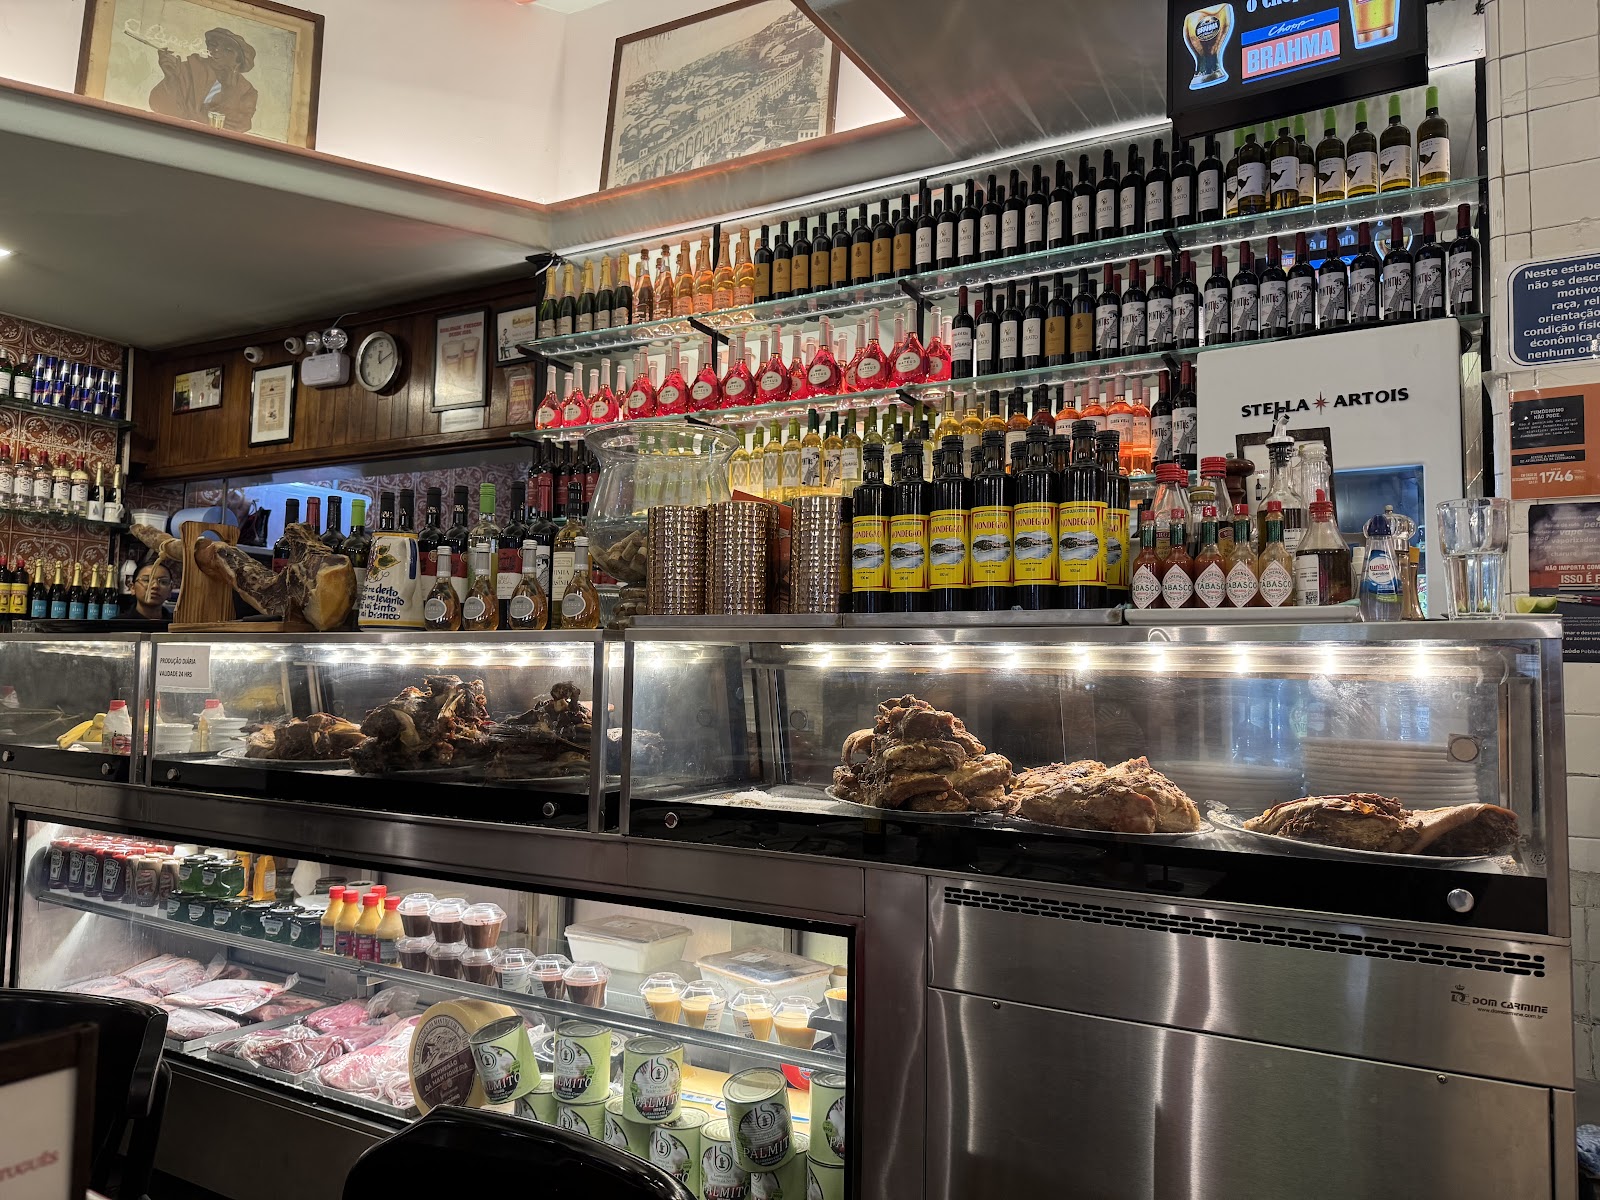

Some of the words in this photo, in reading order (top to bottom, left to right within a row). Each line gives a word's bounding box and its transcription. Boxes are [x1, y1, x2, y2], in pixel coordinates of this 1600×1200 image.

[1268, 18, 1315, 36] Chopp
[1247, 29, 1335, 74] BRAHMA
[1524, 268, 1558, 279] Neste
[1527, 281, 1549, 291] não
[1552, 278, 1566, 287] se
[1551, 300, 1581, 311] raça,
[1538, 308, 1600, 324] orientação
[1523, 323, 1576, 337] condição
[1527, 347, 1575, 360] nenhum
[1241, 399, 1310, 418] STELLA
[1333, 387, 1410, 408] ARTOIS
[1539, 470, 1574, 484] 1746
[1551, 536, 1597, 545] vaporizador
[1560, 574, 1583, 584] ISSO
[1586, 572, 1592, 583] É
[373, 601, 397, 613] tinto
[367, 609, 401, 620] branco
[159, 656, 181, 665] PRODUÇÃO
[182, 657, 197, 665] DIÁRIA
[1472, 996, 1498, 1007] DOM
[1500, 1000, 1549, 1014] CARMINE
[430, 1059, 458, 1079] PARMESÃO
[432, 1062, 469, 1086] MANTIQUEIRA
